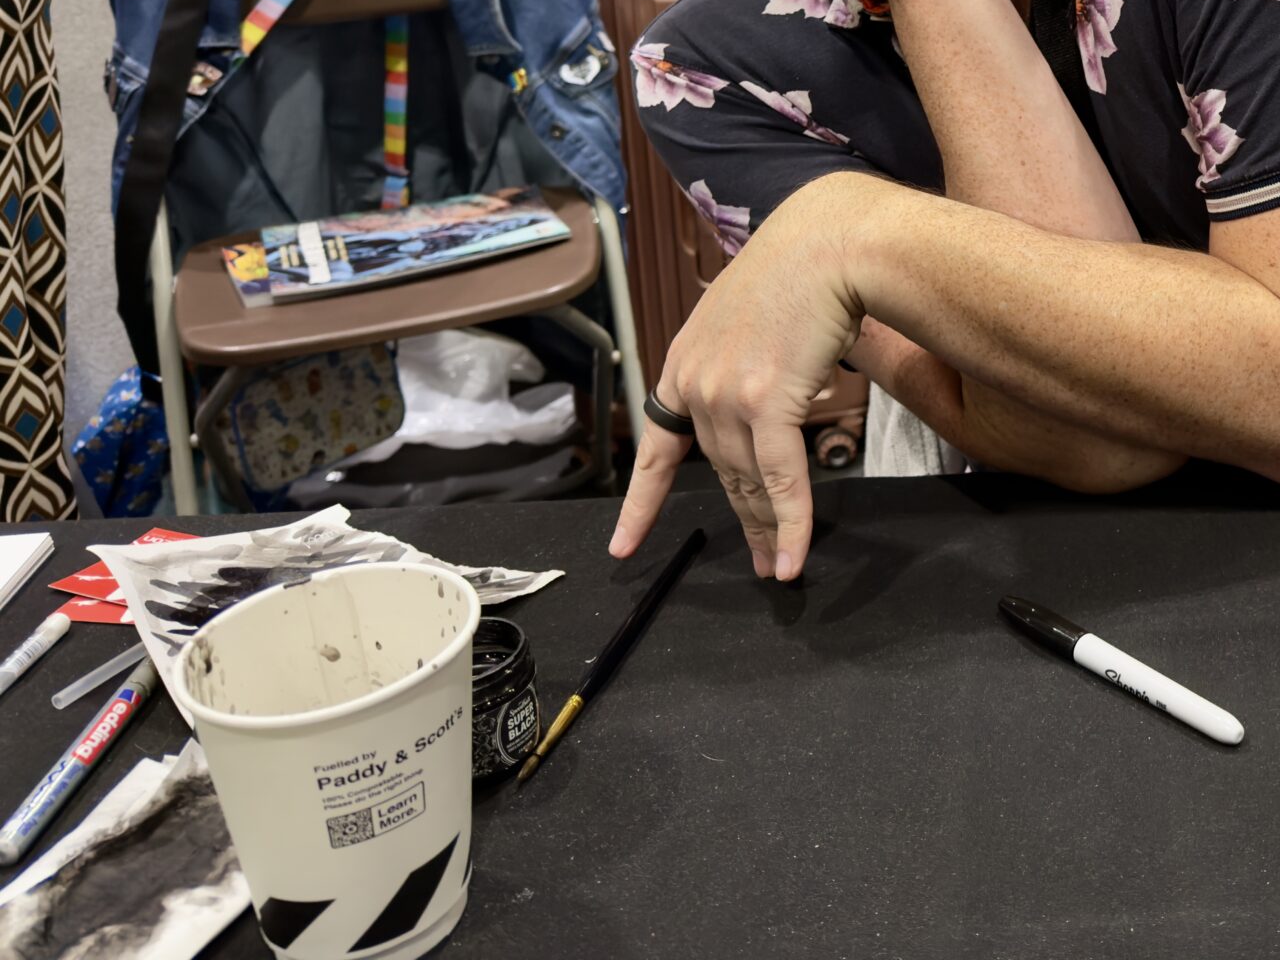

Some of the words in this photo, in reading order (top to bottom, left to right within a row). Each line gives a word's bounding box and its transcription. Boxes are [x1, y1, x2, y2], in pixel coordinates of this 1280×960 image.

[75, 702, 128, 758] edding
[507, 701, 534, 730] SUPER
[508, 711, 536, 741] BLACK
[313, 756, 359, 773] Fuelled
[362, 750, 377, 762] by
[317, 761, 387, 790] Paddy
[395, 749, 408, 765] &
[414, 706, 464, 753] Scott's
[378, 793, 418, 818] Learn
[379, 807, 418, 830] More.
